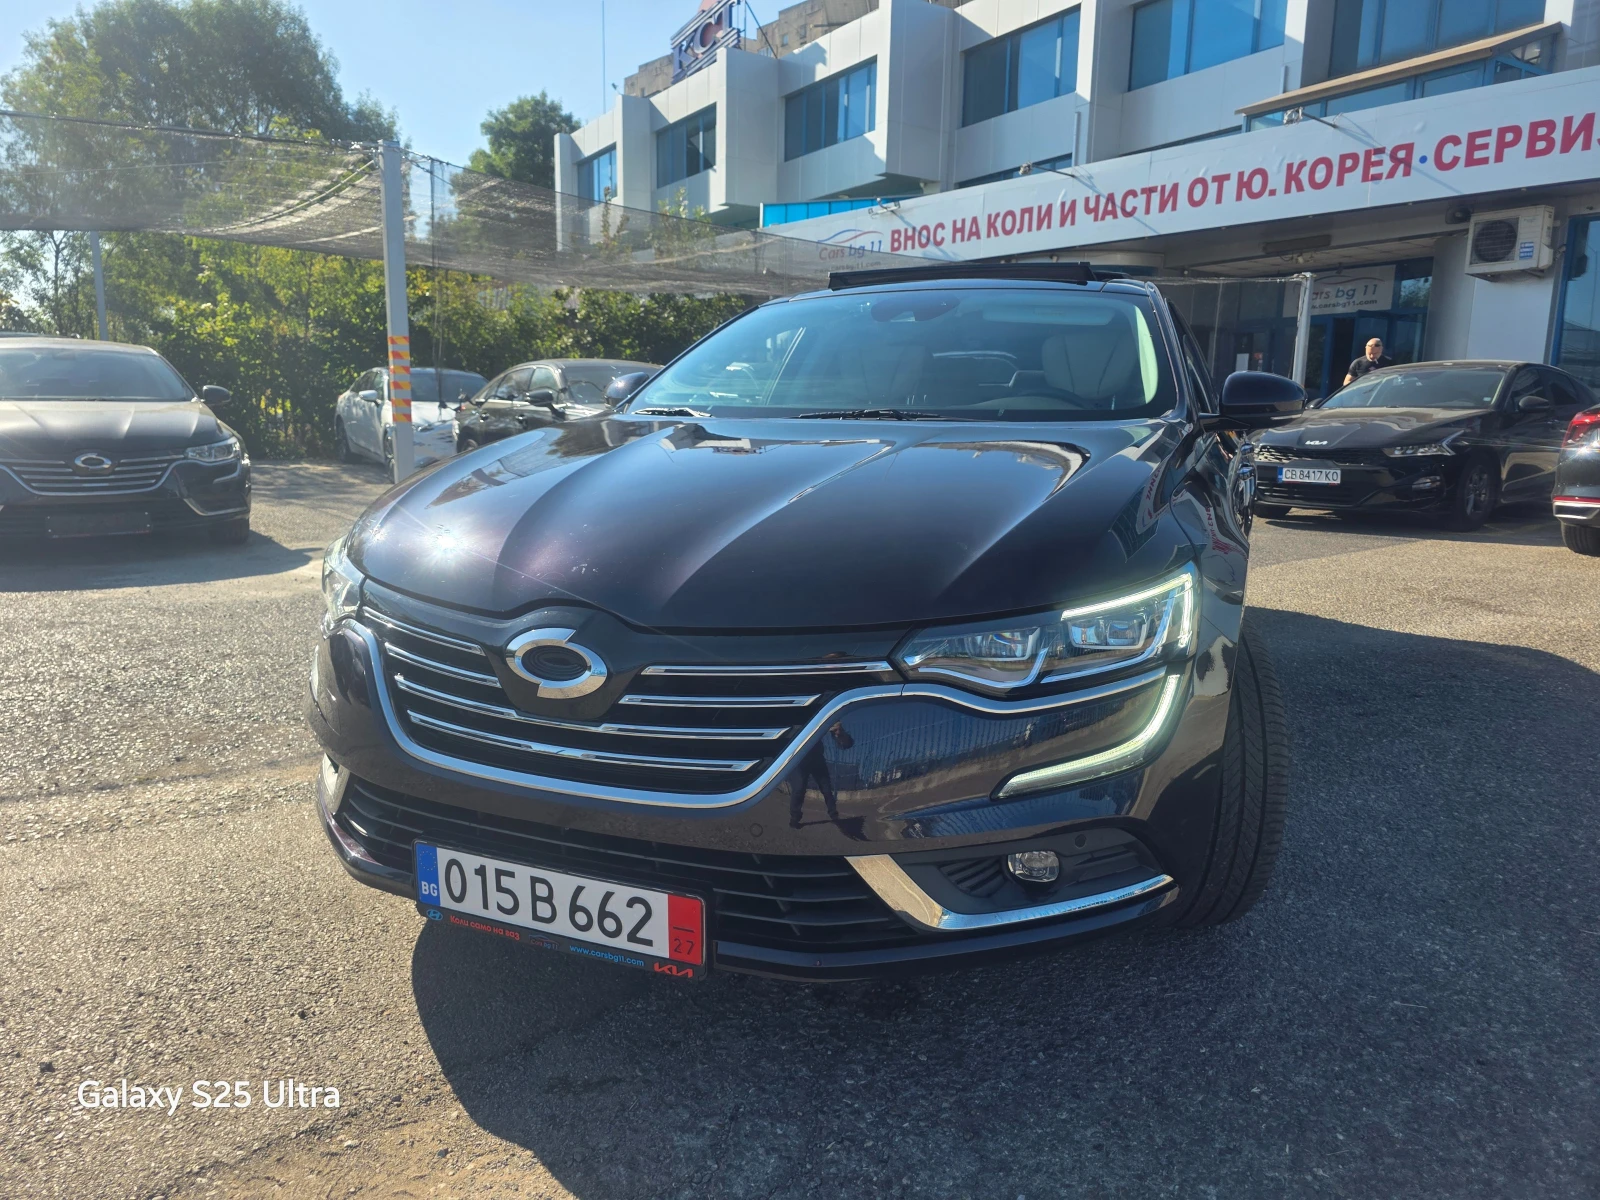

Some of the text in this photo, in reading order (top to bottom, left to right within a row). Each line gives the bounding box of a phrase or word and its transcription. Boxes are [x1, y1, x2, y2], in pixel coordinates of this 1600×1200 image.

[890, 112, 1600, 253] ВНОС НА КОЛИ И ЧАСТИ ОТ Ю. КОРЕЯ СЕРВИ
[849, 243, 866, 259] bg
[1335, 287, 1356, 299] bg
[1363, 284, 1378, 296] 11
[1284, 469, 1297, 480] CB
[1299, 470, 1323, 481] 8417
[1325, 471, 1339, 481] KO
[421, 881, 438, 897] BG
[444, 858, 653, 948] 015 B 662
[449, 915, 469, 927] Коли
[470, 922, 492, 932] само
[493, 927, 504, 936] на
[673, 937, 695, 955] 27
[569, 944, 645, 967] www.carsbg11.com
